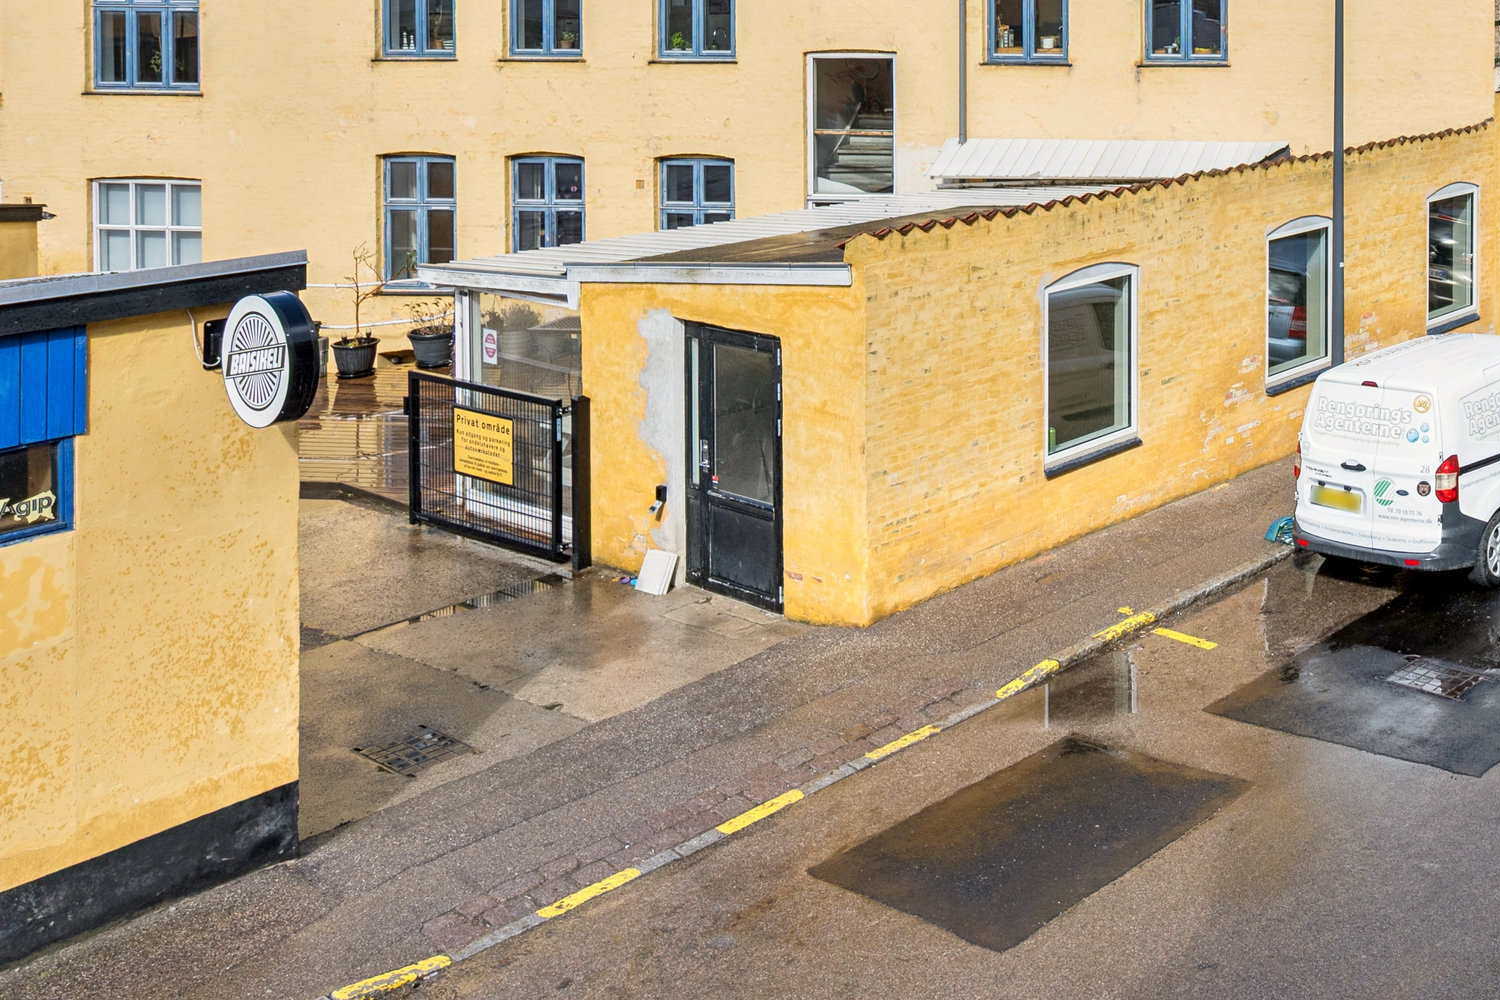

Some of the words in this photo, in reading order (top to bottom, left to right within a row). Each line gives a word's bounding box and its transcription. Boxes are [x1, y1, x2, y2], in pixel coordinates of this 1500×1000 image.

[230, 345, 284, 376] BAISIKELI
[456, 414, 479, 428] Privat
[481, 421, 510, 435] område
[1315, 411, 1401, 439] Agenterne
[1420, 465, 1430, 474] 28
[0, 496, 52, 519] Agip
